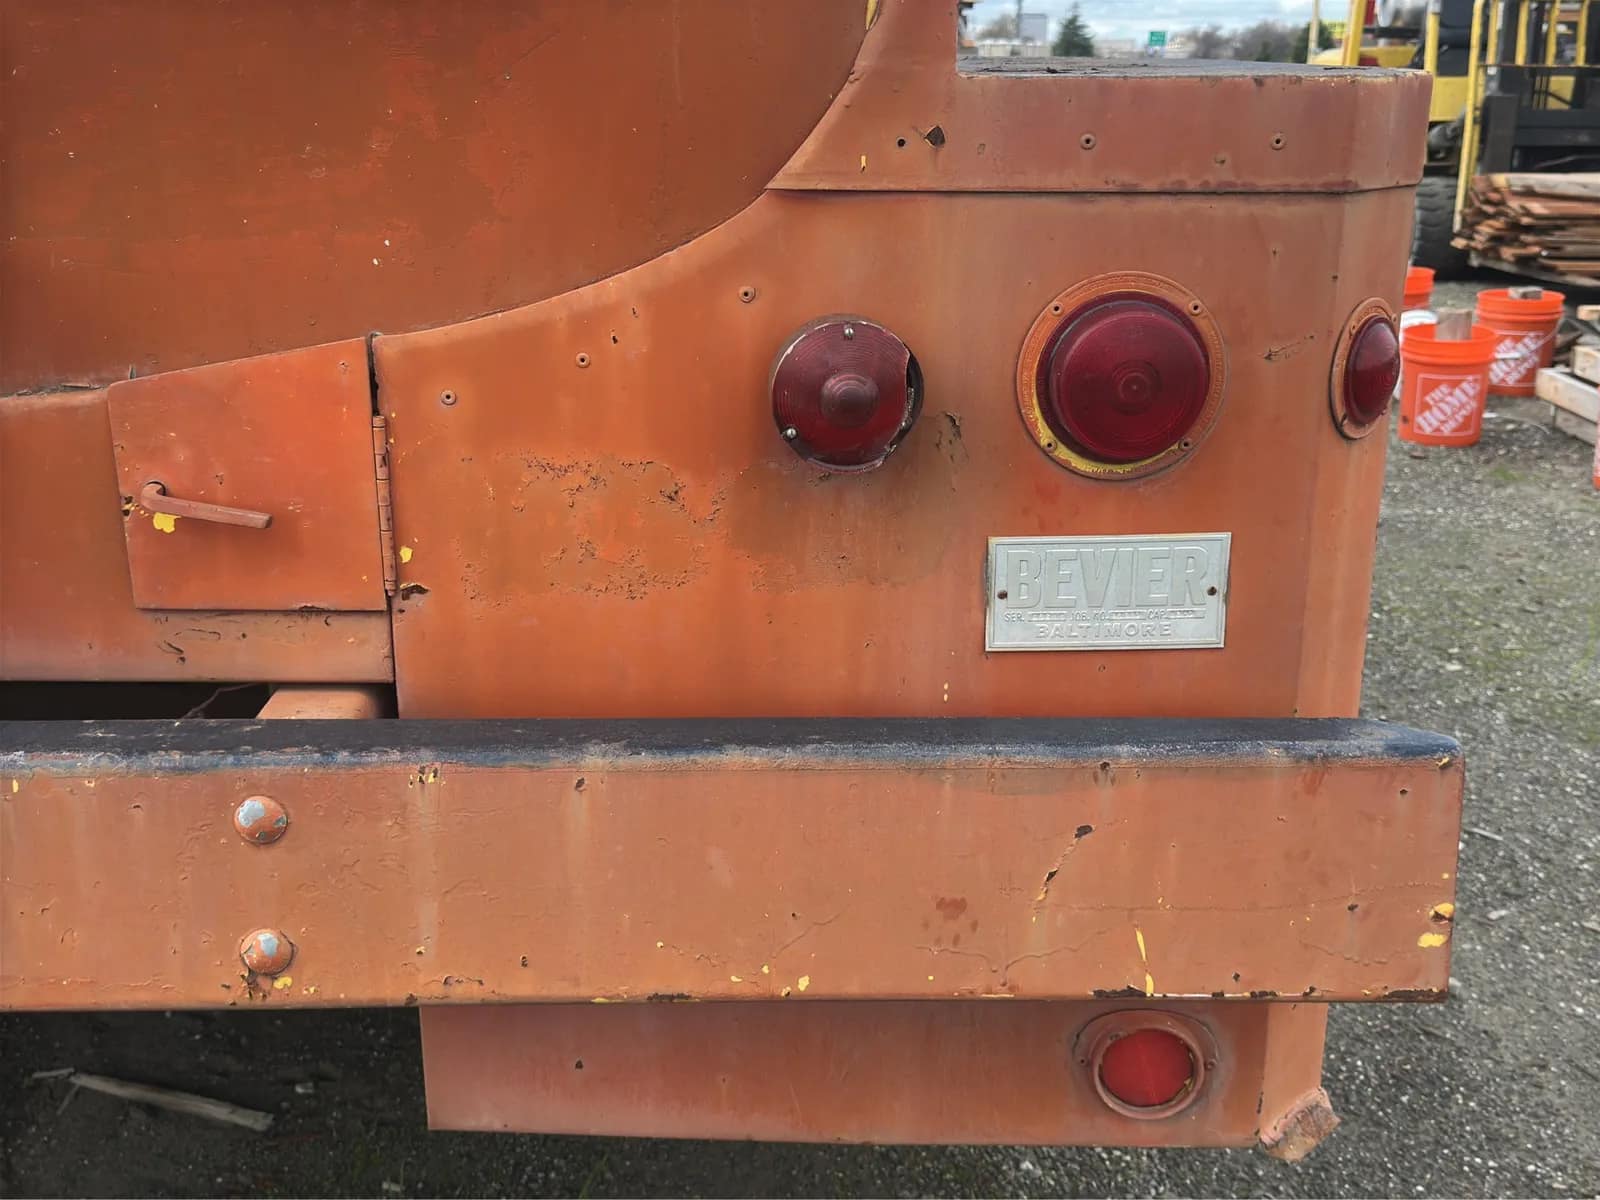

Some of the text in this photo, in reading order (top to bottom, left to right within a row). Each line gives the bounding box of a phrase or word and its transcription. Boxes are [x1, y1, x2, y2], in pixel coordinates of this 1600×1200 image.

[1416, 376, 1480, 434] HOME
[1006, 545, 1208, 609] BEVIER
[1035, 621, 1173, 639] BALTIMORE
